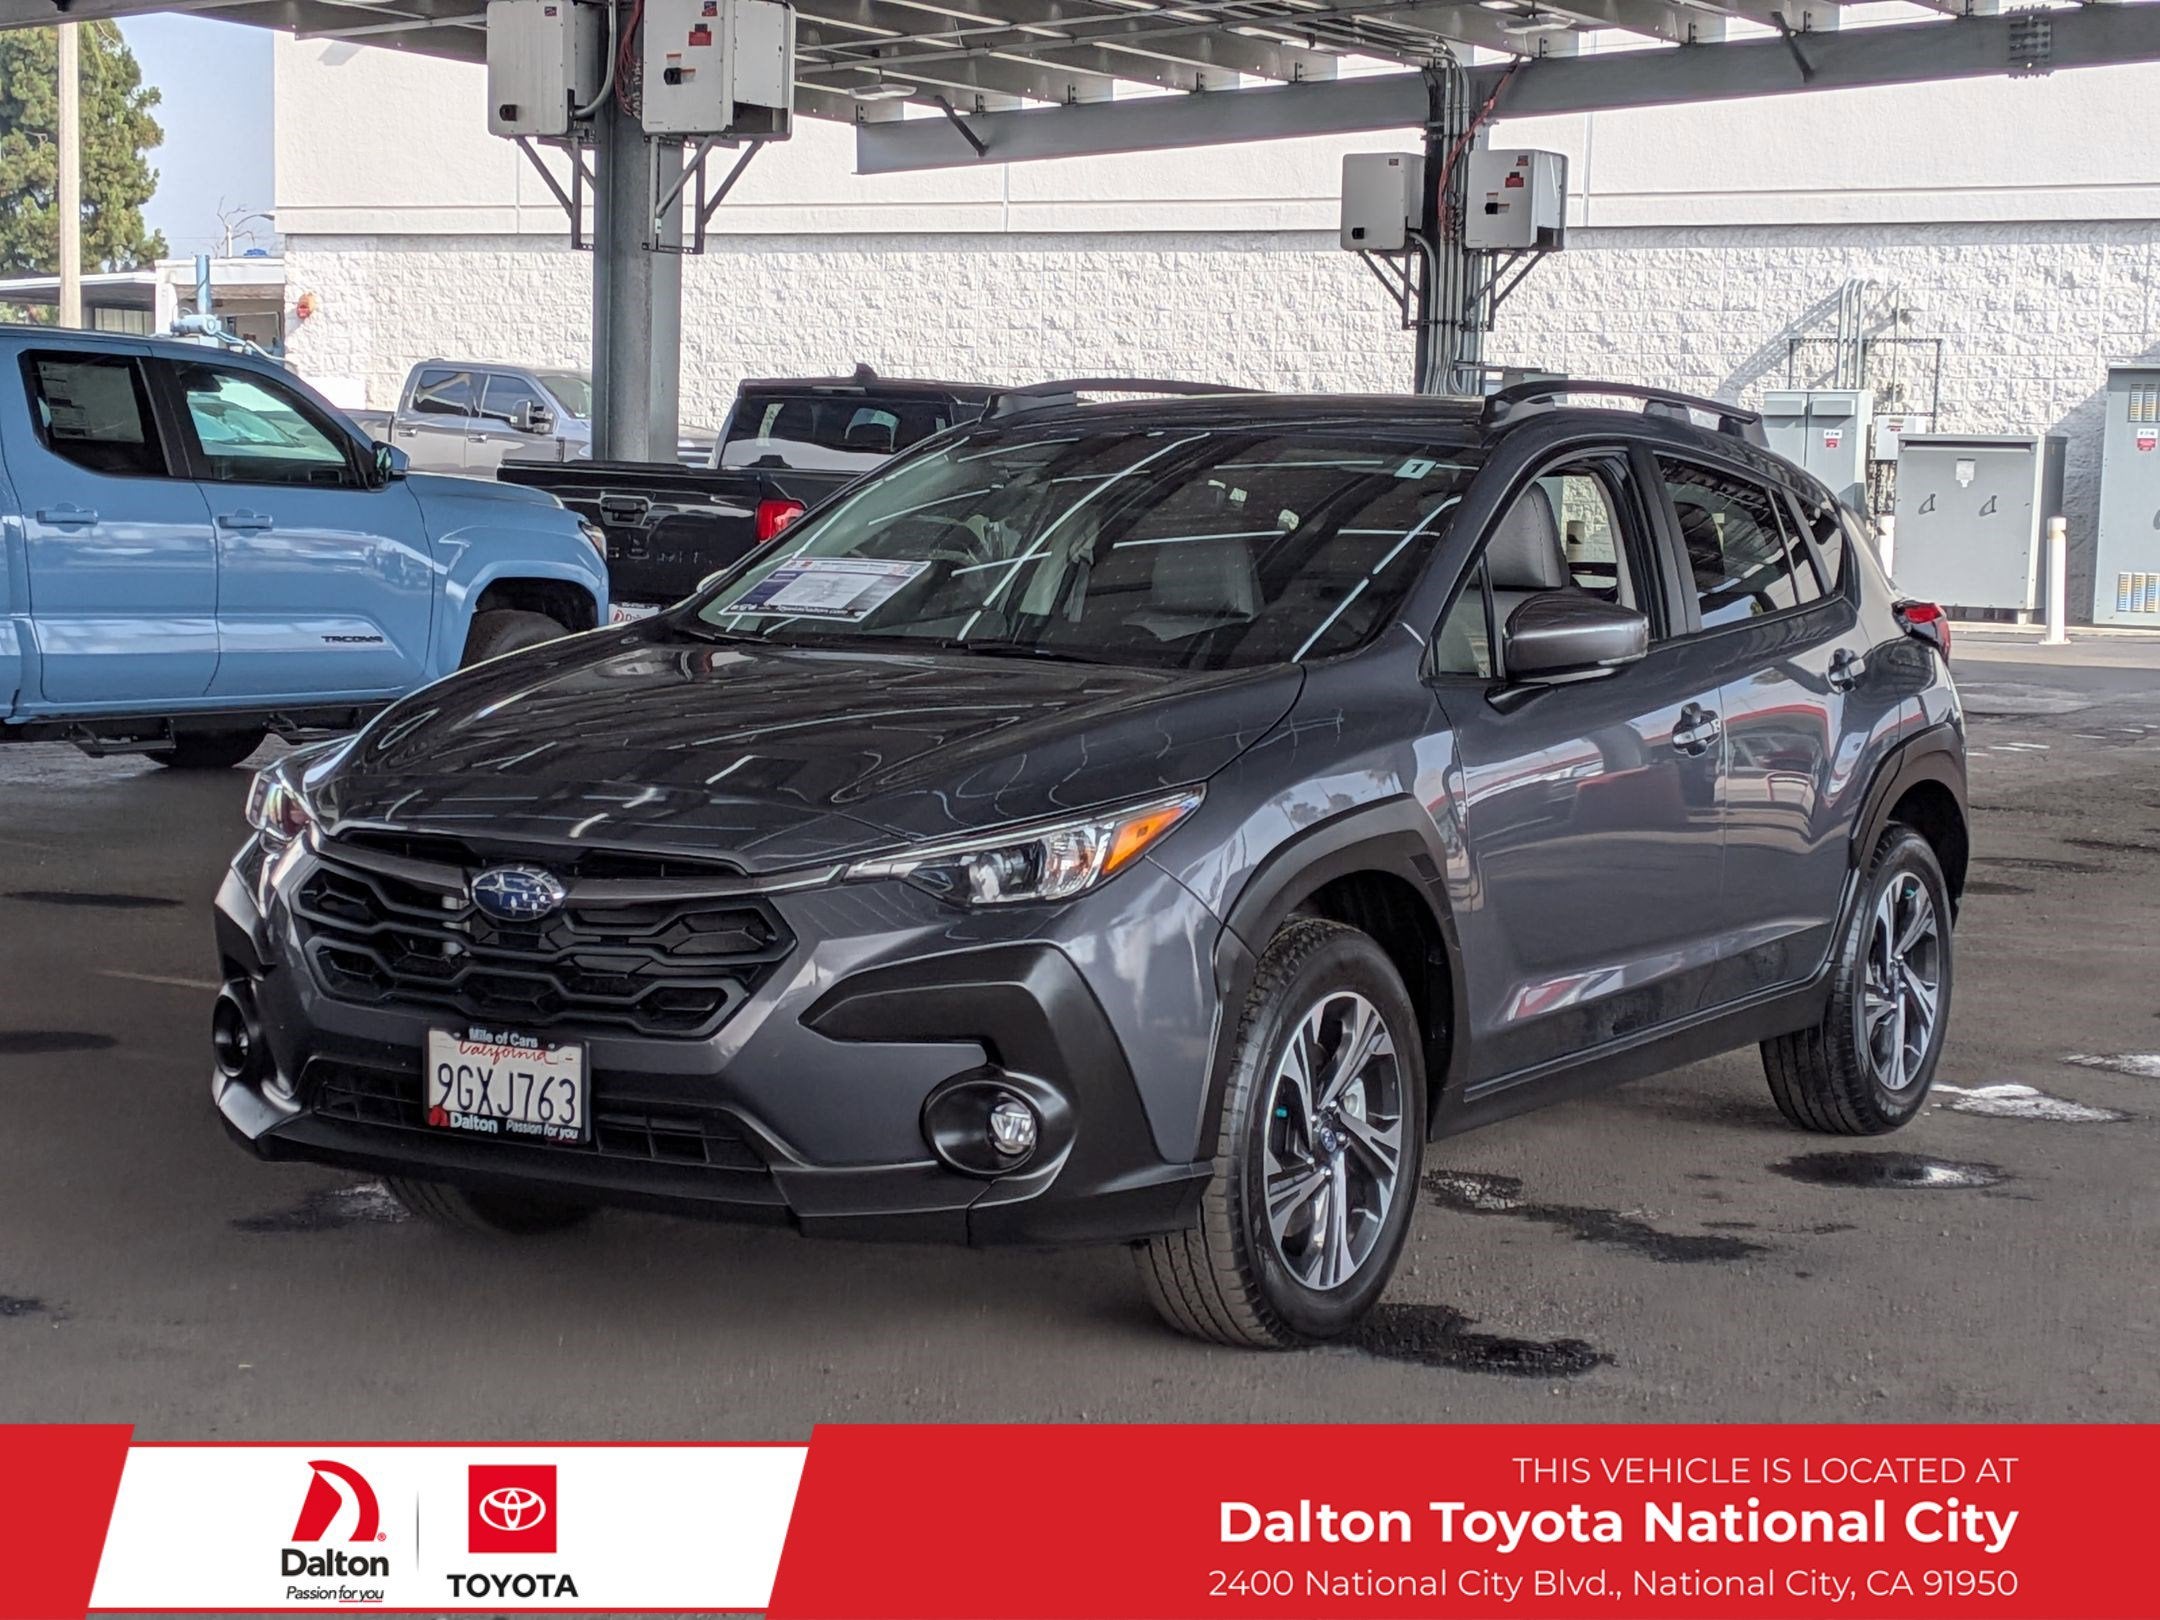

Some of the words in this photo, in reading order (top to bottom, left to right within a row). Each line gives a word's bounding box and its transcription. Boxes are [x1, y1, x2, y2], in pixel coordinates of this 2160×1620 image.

[1411, 463, 1424, 474] 1
[320, 635, 384, 643] TACOMA
[468, 1027, 493, 1043] Mile
[495, 1032, 509, 1045] of
[509, 1033, 539, 1048] Cars
[437, 1063, 576, 1125] 9GXJ763
[450, 1113, 498, 1133] Dalton
[505, 1119, 543, 1135] Passion
[543, 1125, 558, 1137] for
[558, 1129, 579, 1141] you
